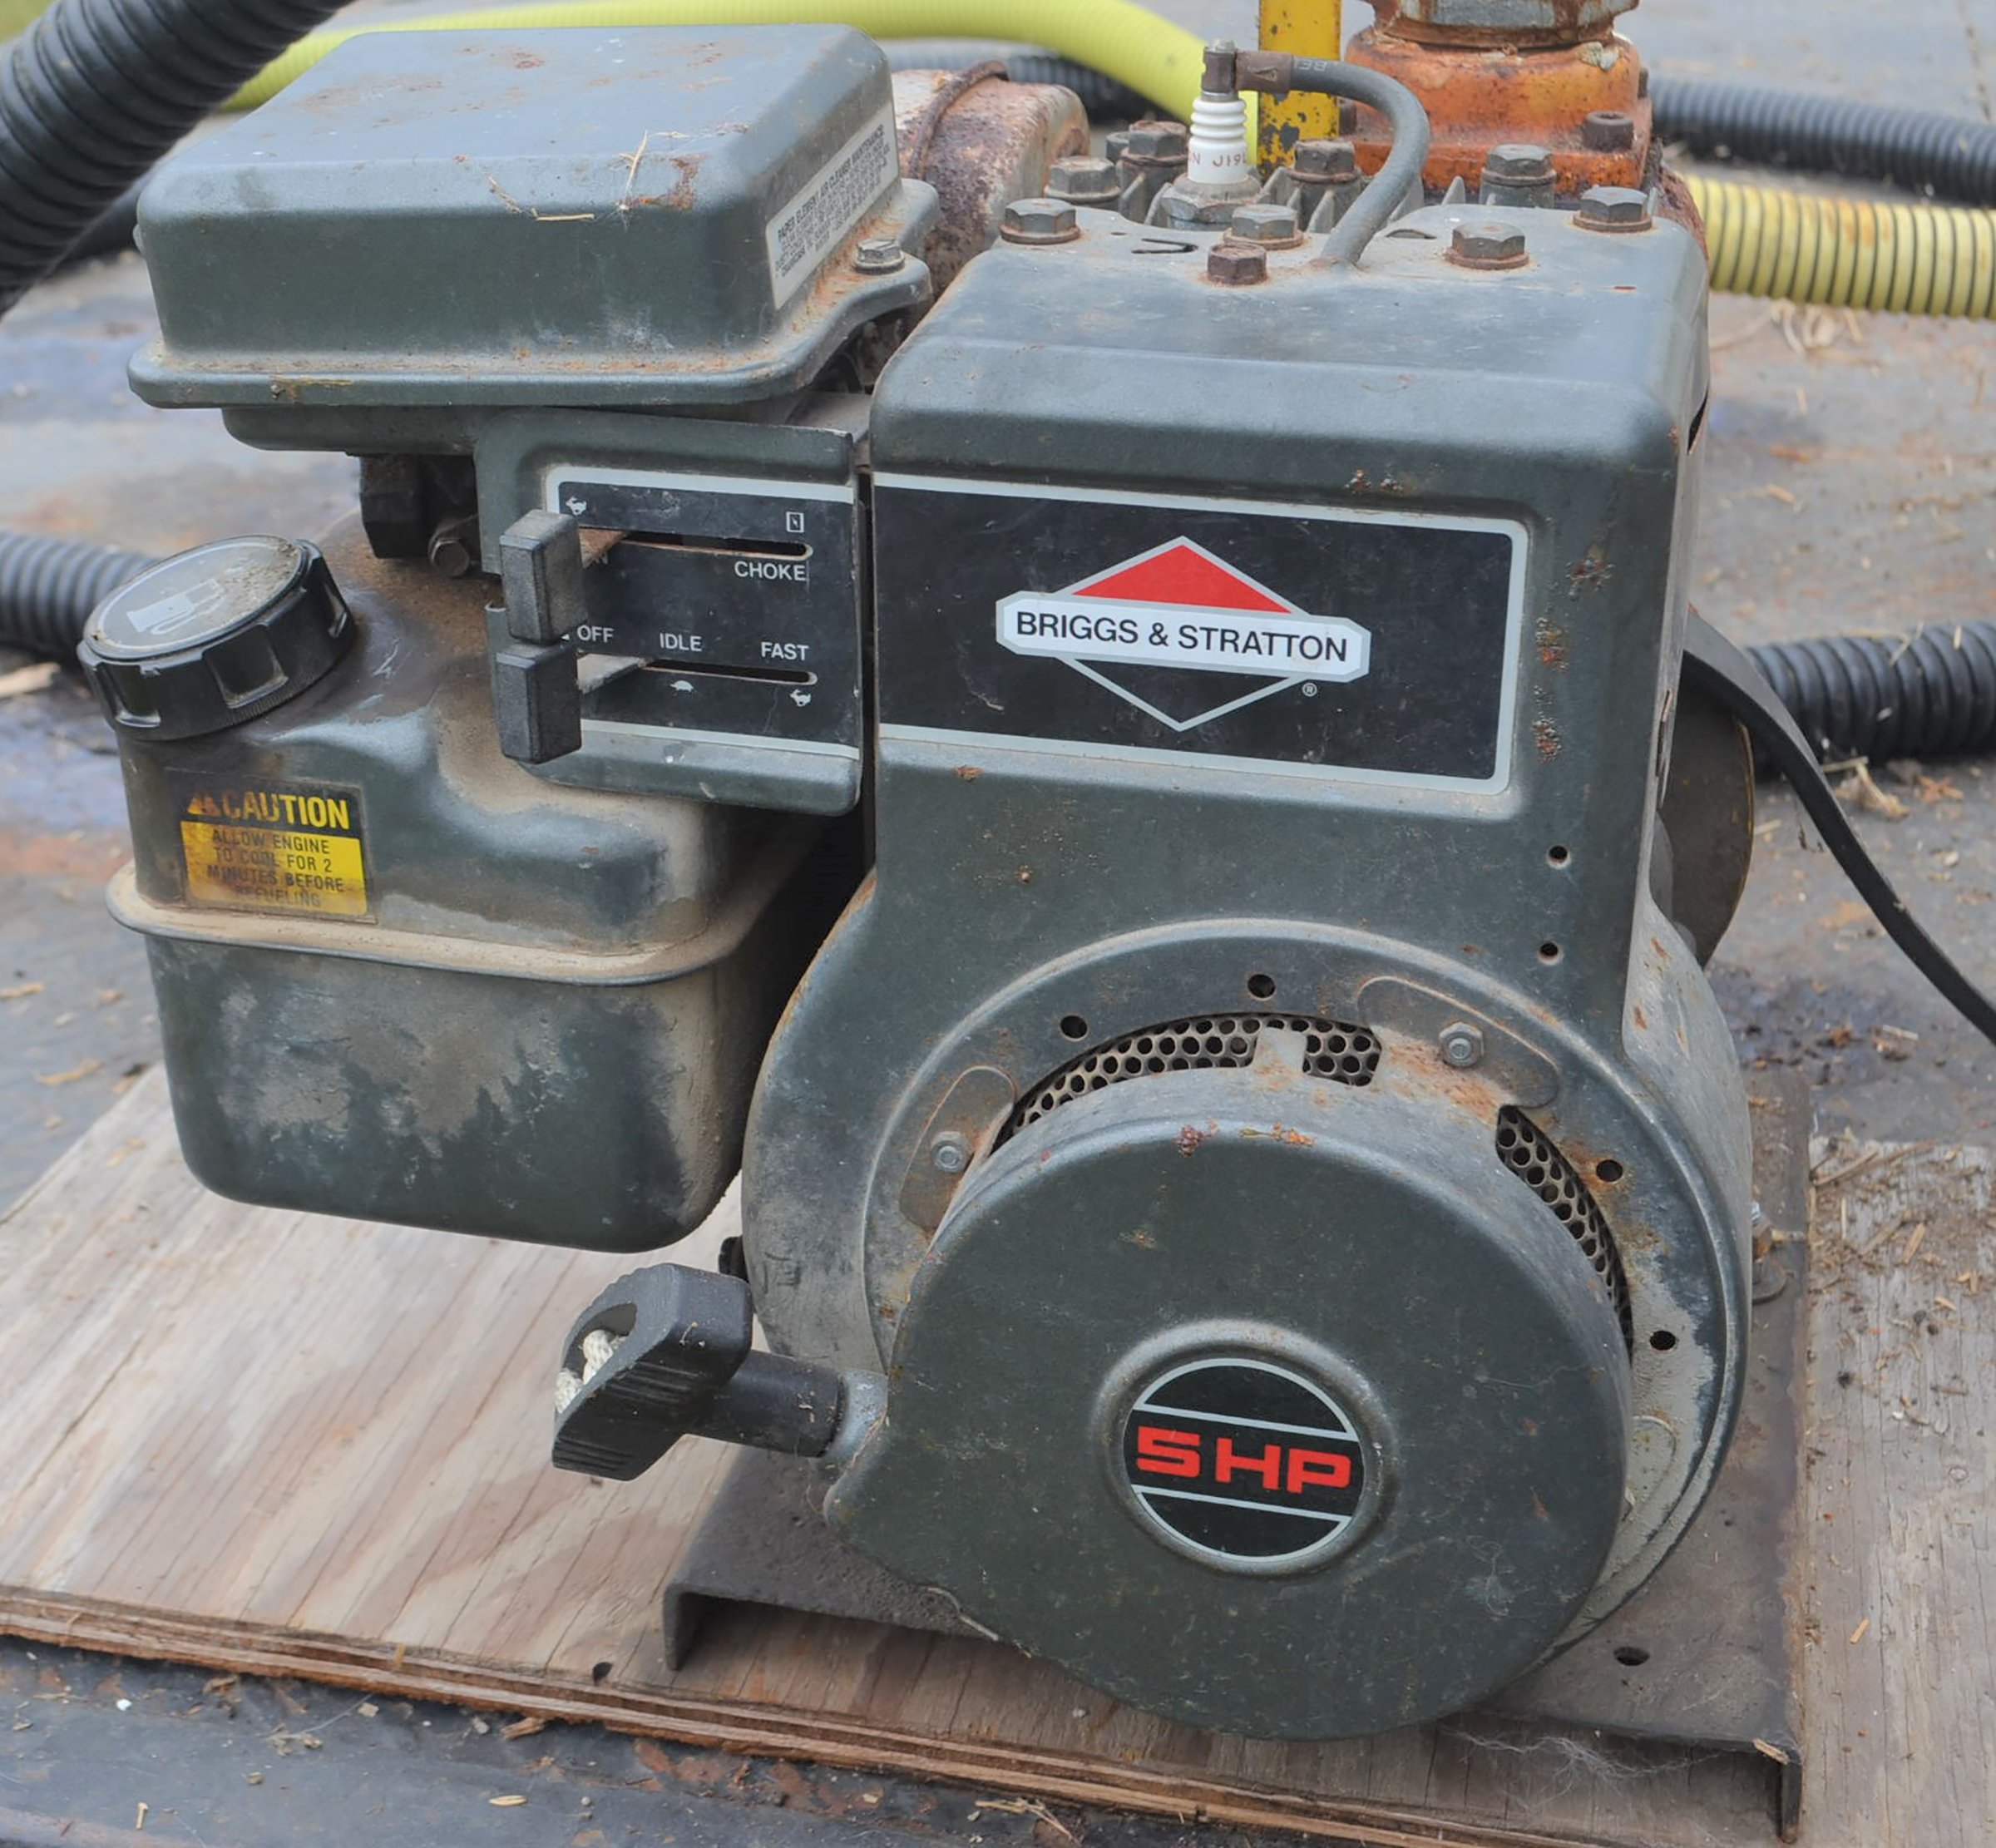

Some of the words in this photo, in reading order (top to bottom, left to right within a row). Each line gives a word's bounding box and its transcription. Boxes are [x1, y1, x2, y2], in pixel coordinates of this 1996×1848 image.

[734, 561, 807, 581] CHOKE
[577, 625, 615, 643] OFF
[660, 632, 703, 652] IDLE
[1015, 610, 1139, 644] BRIGGS
[1149, 623, 1169, 647] &
[1178, 624, 1347, 662] STRATTON
[761, 641, 809, 661] FAST
[222, 791, 349, 830] CAUTION
[212, 828, 265, 847] ALLOW
[273, 834, 330, 854] ENGINE
[214, 847, 234, 862] TO
[240, 850, 279, 867] COOL
[287, 854, 317, 871] FOR
[324, 858, 332, 873] 2
[207, 865, 277, 886] MINUTES
[285, 873, 345, 892] BEFORE
[1215, 1437, 1351, 1494] HP
